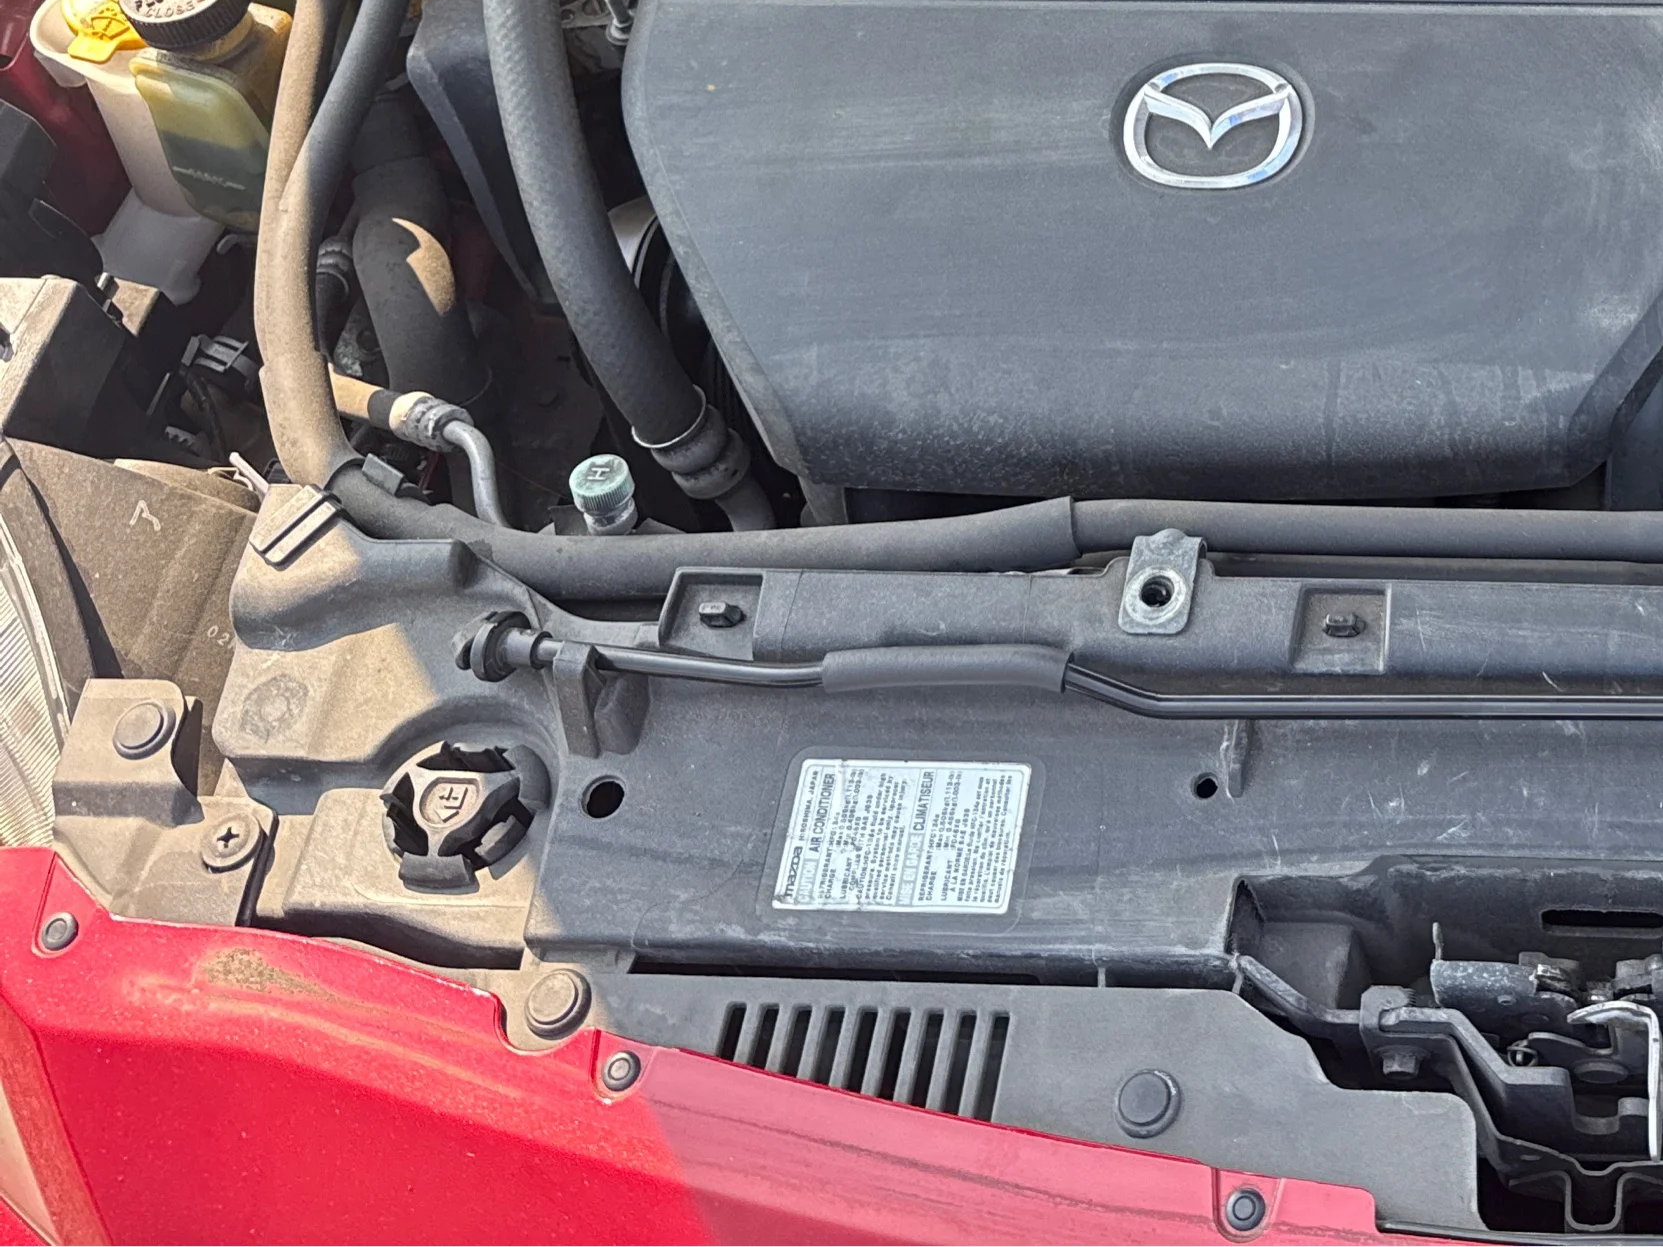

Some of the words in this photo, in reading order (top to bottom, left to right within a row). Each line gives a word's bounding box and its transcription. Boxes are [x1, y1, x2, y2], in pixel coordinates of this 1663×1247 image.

[145, 0, 195, 19] CLOSE
[812, 773, 835, 833] CONDITIONER
[912, 771, 934, 830] CLIMATISEUR
[784, 846, 803, 896] mazda
[807, 770, 818, 794] JAPAN
[808, 836, 822, 852] AIR
[905, 835, 922, 866] GARDE
[797, 861, 816, 901] CAUTION
[839, 857, 853, 898] LUBRICANT
[898, 882, 914, 904] MISE
[940, 859, 953, 900] LUBRICANT
